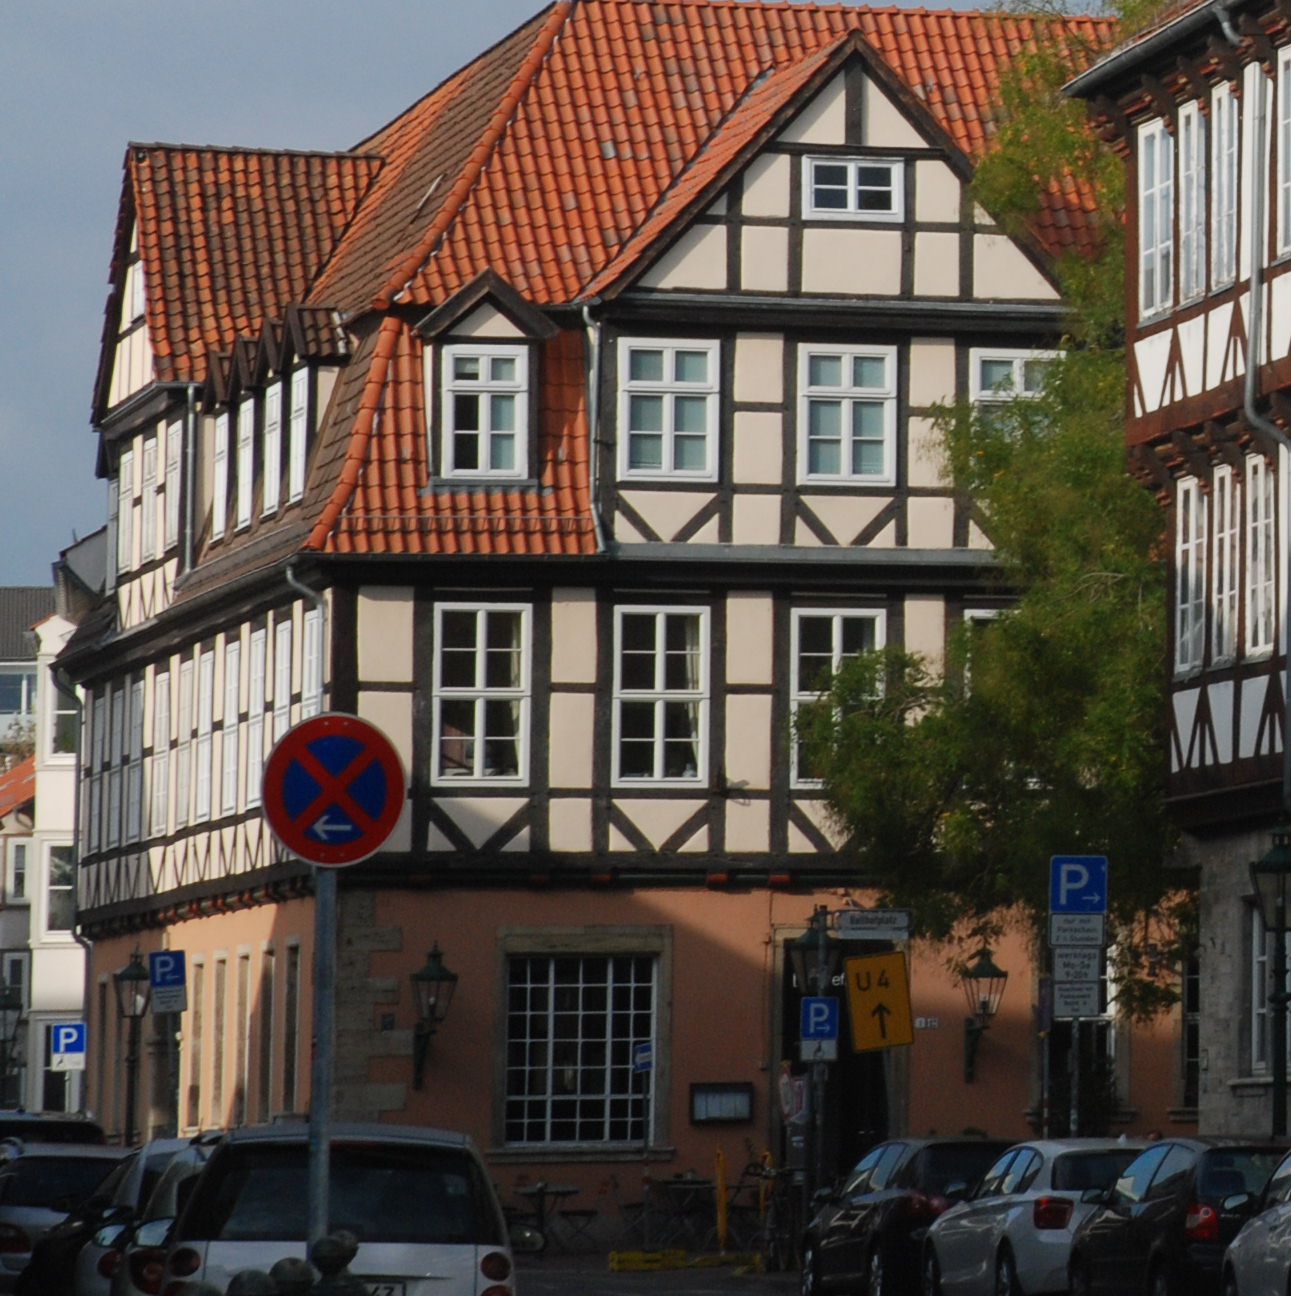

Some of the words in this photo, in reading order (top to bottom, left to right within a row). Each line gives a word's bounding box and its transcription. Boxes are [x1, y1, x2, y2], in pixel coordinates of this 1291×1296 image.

[1059, 863, 1090, 905] P
[155, 956, 175, 983] P
[809, 1003, 829, 1034] P
[59, 1027, 78, 1053] P
